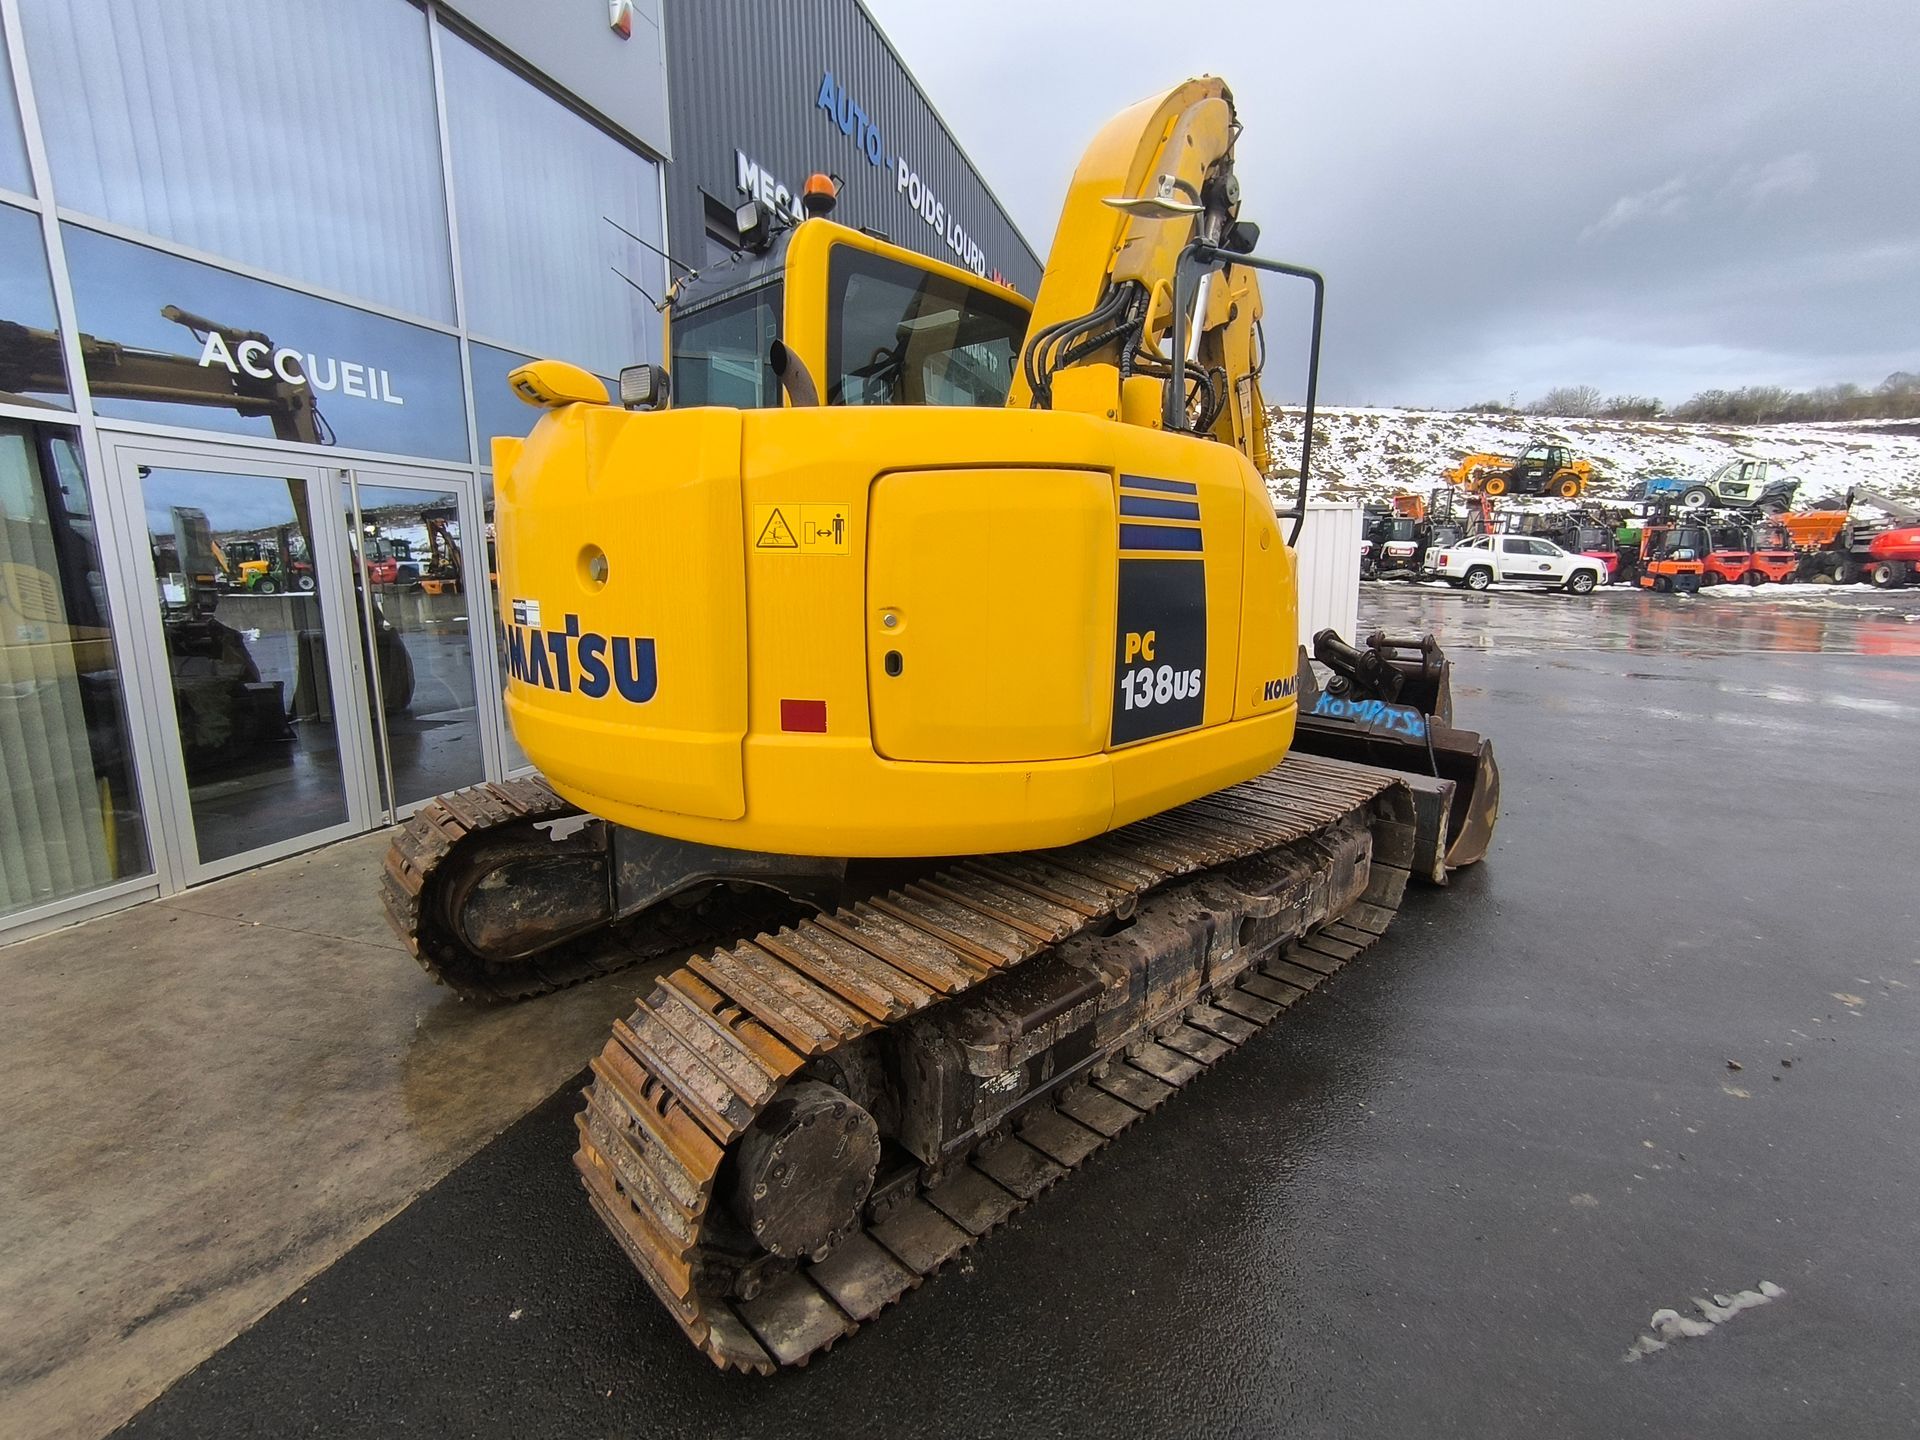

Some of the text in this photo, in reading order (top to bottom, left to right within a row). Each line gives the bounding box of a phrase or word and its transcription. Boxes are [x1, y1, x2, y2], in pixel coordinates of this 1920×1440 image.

[735, 148, 810, 226] MECA
[816, 71, 882, 166] AUTO
[897, 156, 945, 236] POIDS
[946, 213, 986, 278] LOURD
[198, 331, 404, 405] ACCUEIL
[1124, 630, 1156, 664] PC
[1121, 664, 1202, 711] 138US
[1264, 673, 1298, 701] KOMA
